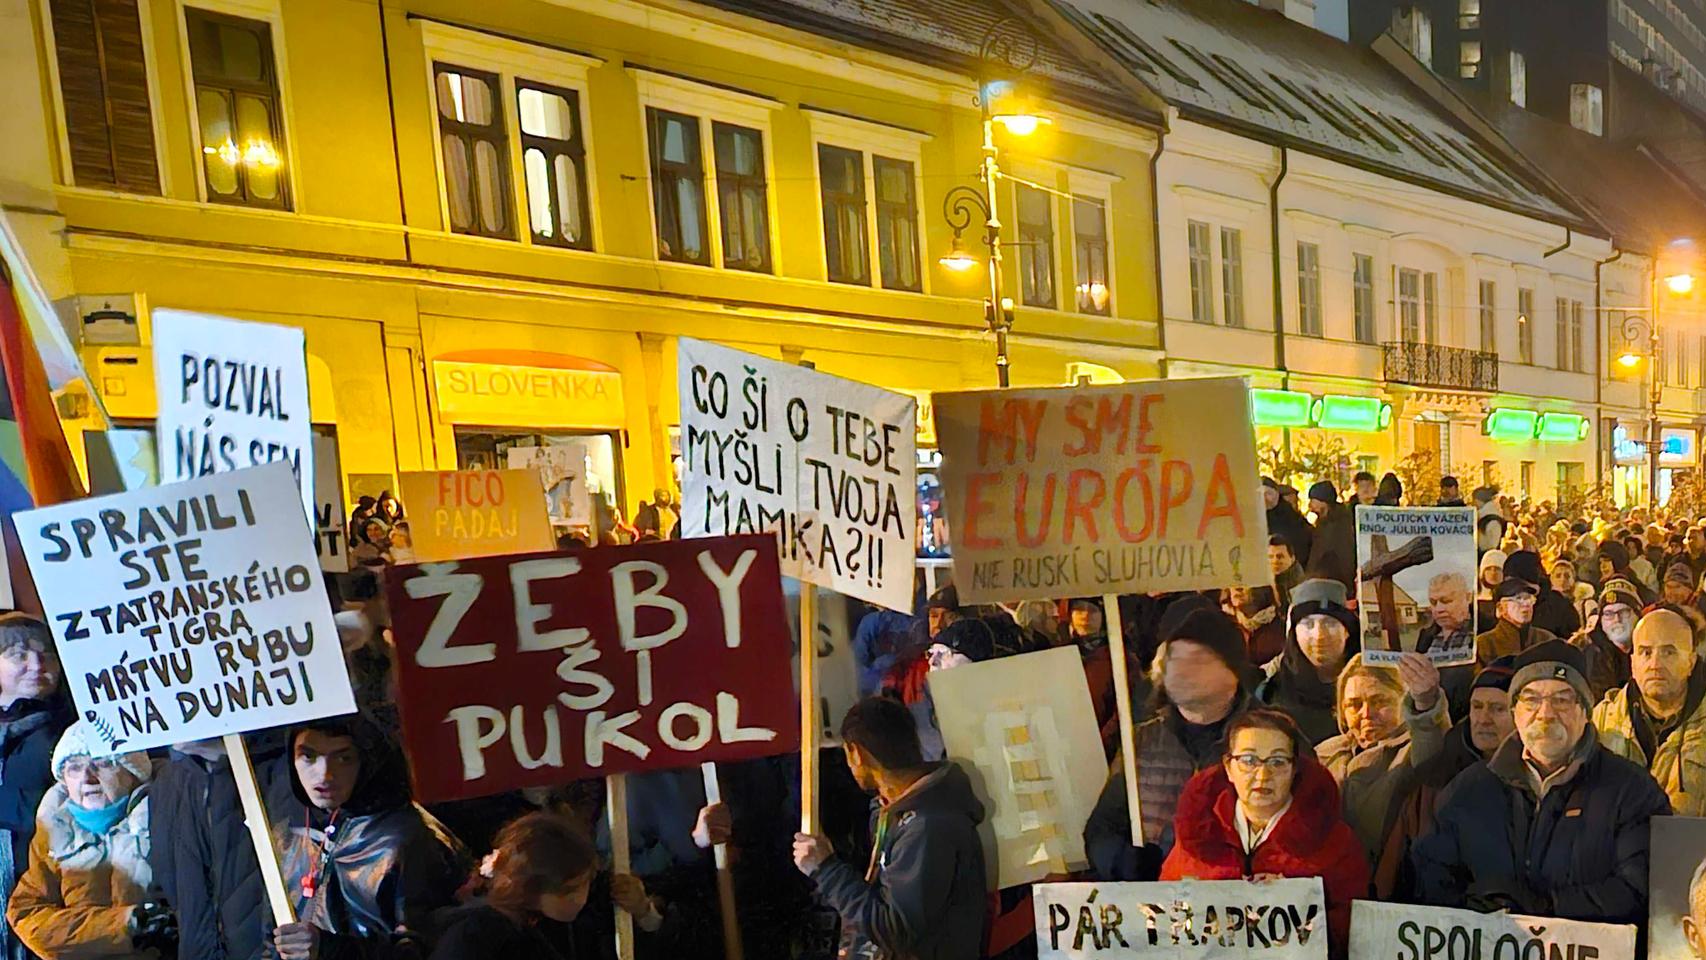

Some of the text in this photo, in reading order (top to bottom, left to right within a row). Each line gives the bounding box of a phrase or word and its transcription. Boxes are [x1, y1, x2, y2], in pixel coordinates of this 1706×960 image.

[182, 353, 289, 421] POZVAL
[450, 370, 608, 400] SLOVENKA
[691, 365, 728, 419] CO
[787, 398, 809, 442] O
[826, 405, 901, 475] TEBE
[176, 415, 237, 479] NÁS
[977, 397, 1047, 466] MY
[1062, 391, 1166, 456] SME
[40, 488, 256, 562] SPRAVILI
[435, 509, 519, 539] PADAJ
[439, 470, 505, 508] FICO
[805, 458, 905, 540] TVOJA
[962, 453, 1246, 549] EURÓPA
[120, 539, 208, 591] STE
[972, 558, 1004, 592] NIE
[1092, 541, 1216, 585] SLUHOVIA
[141, 608, 253, 652] TIGRA
[404, 549, 757, 667] ŽEBY
[85, 622, 314, 705] MŔTVU RYBU
[118, 661, 315, 737] NA DUNAJI
[556, 638, 653, 711] ŠI
[442, 691, 778, 781] PUKOL
[1048, 888, 1318, 950] PÁR TRAPKOV
